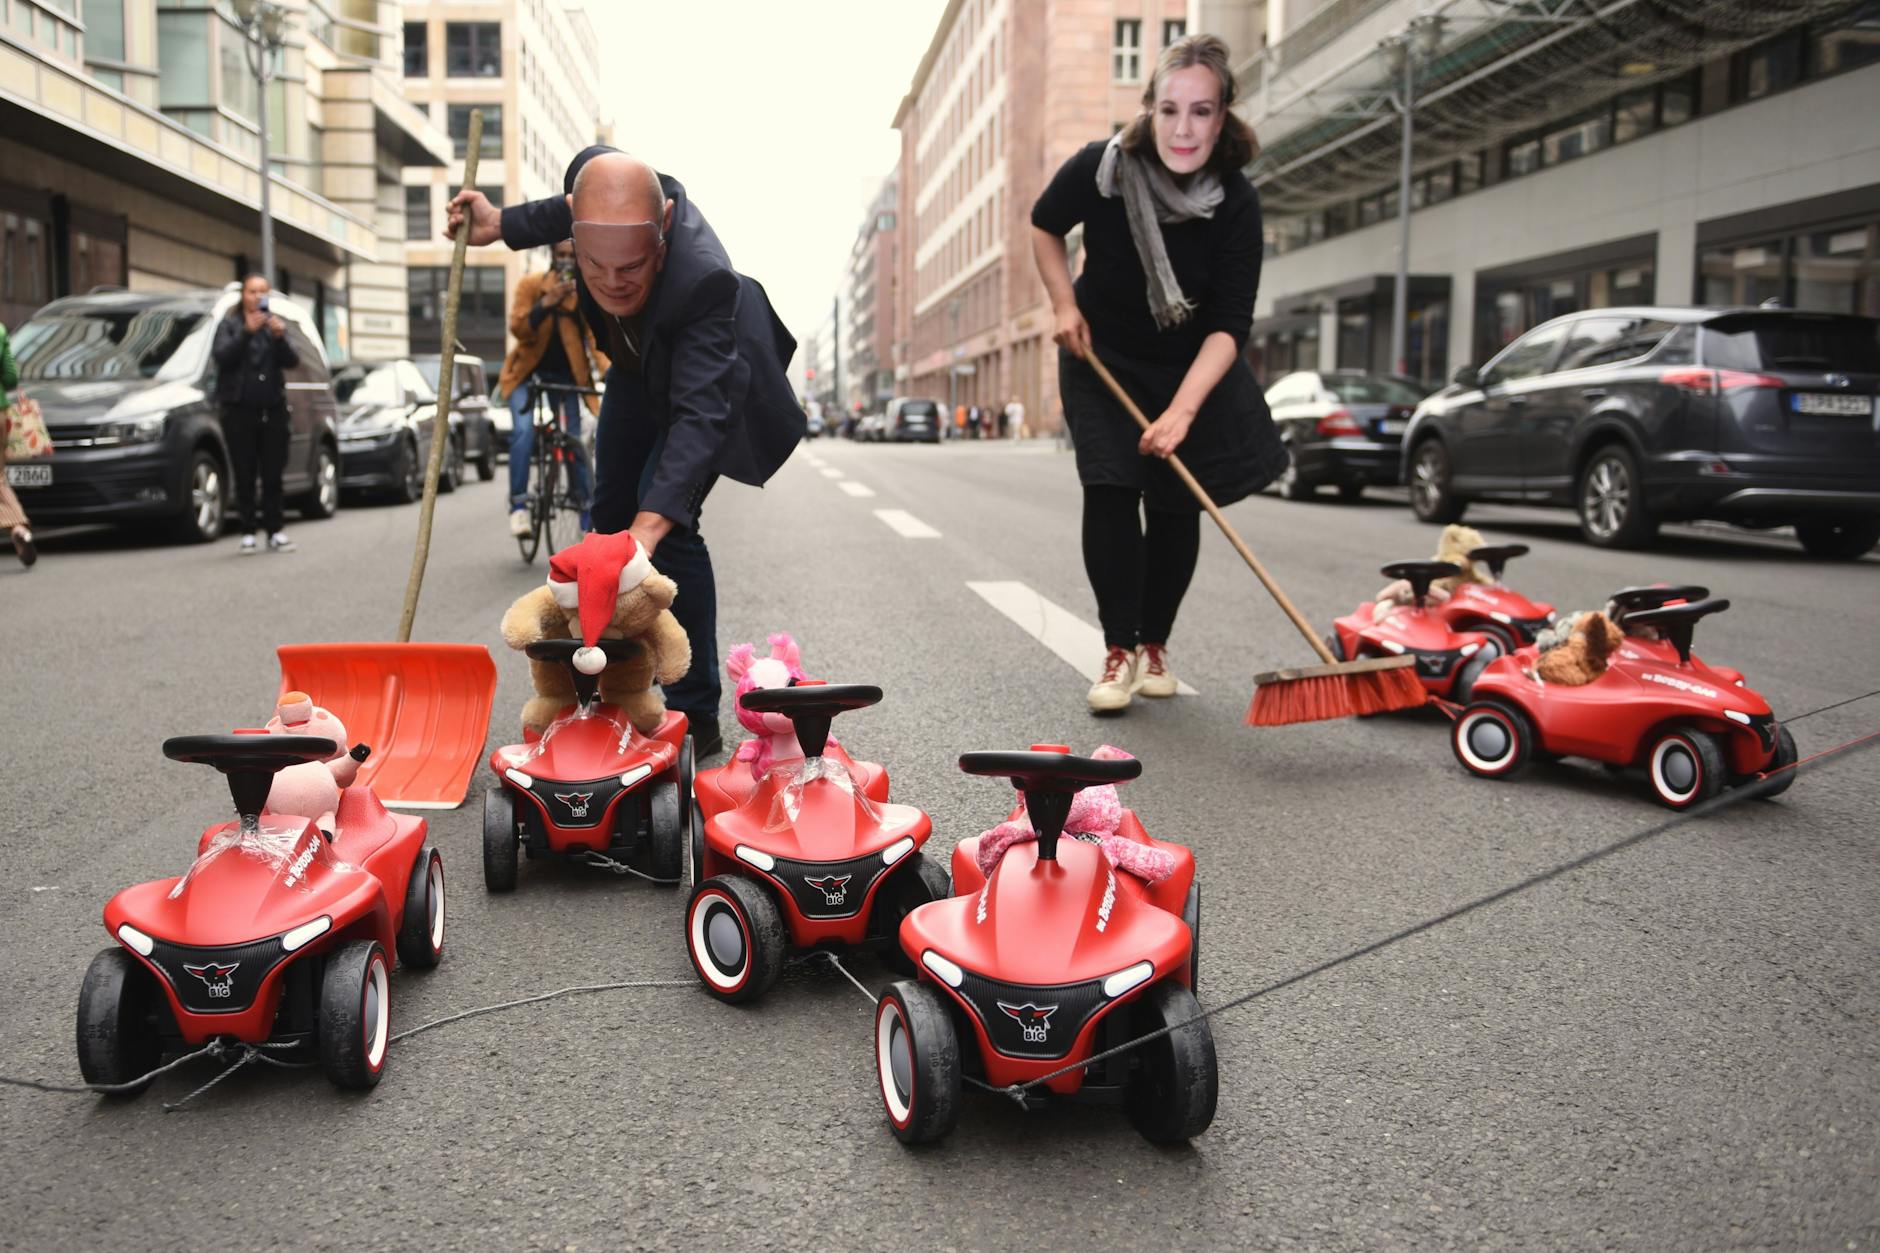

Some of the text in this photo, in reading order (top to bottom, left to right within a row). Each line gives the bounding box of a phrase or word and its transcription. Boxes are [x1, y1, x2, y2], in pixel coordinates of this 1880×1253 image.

[572, 808, 587, 817] BIG
[290, 834, 321, 879] BOBBY-CAR
[826, 895, 844, 905] BIG
[209, 987, 230, 998] BIG
[1024, 1030, 1047, 1042] BIG
